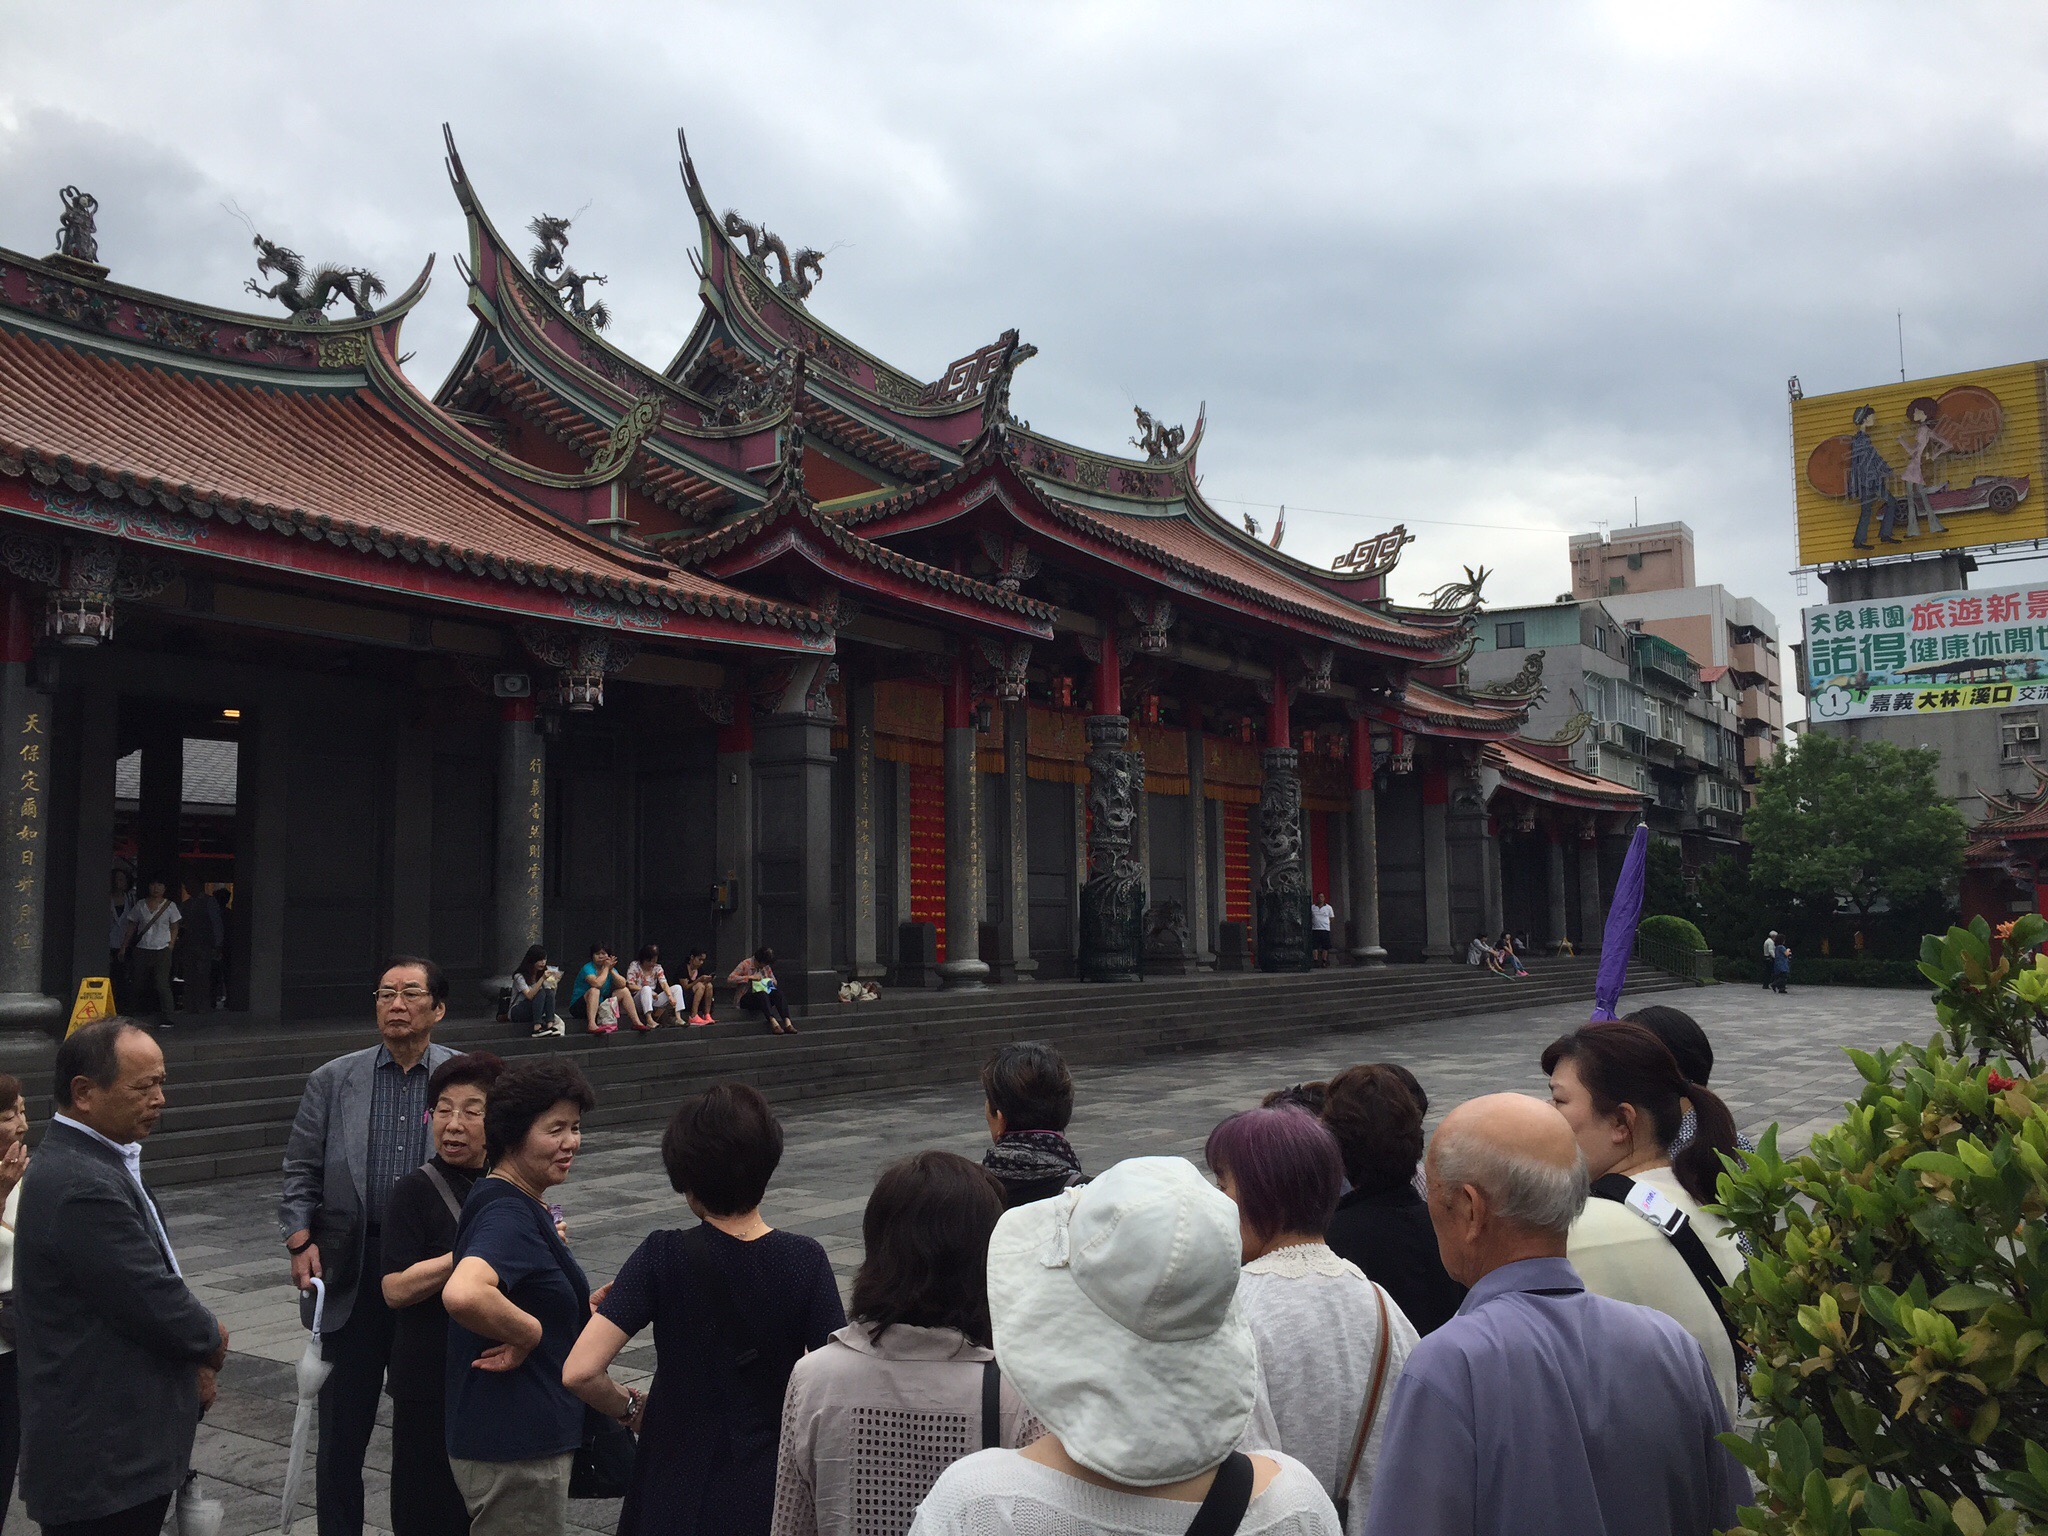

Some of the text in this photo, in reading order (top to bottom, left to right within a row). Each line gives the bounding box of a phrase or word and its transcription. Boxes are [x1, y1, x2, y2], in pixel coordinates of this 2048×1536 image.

[1811, 604, 1905, 635] 天良集團
[1812, 632, 1907, 677] 諾得
